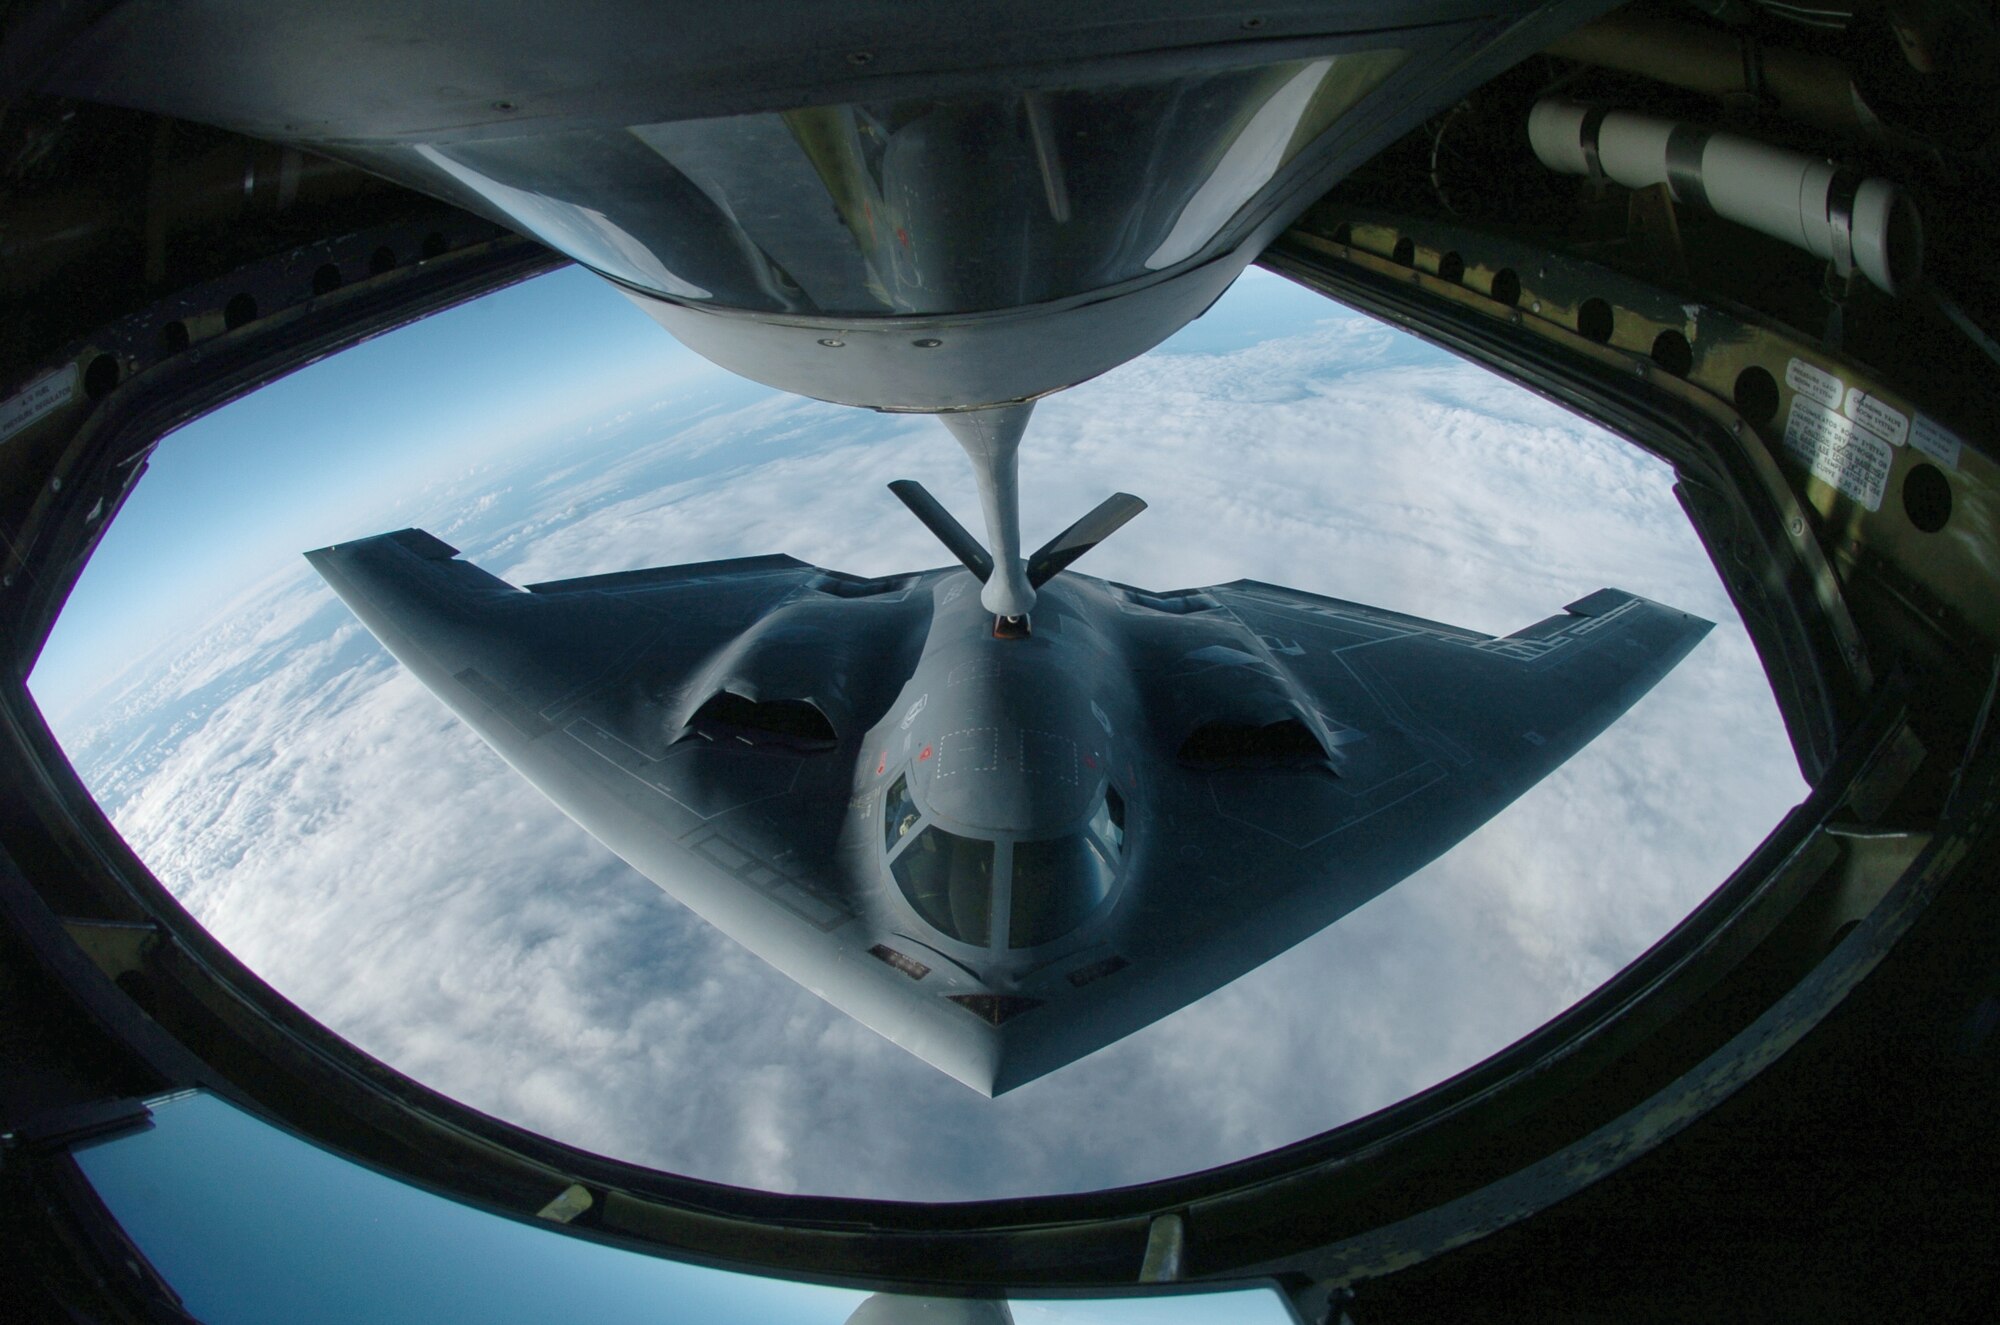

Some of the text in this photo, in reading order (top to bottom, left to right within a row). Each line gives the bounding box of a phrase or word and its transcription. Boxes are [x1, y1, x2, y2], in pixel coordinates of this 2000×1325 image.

[35, 386, 71, 410] REGULATOR
[1791, 408, 1814, 426] CHARGE
[1816, 423, 1832, 436] WITH
[1834, 433, 1846, 444] DRY
[1794, 401, 1837, 429] ACCUMULATOR
[1840, 426, 1858, 441] BOOM
[1861, 439, 1885, 457] SYSTEM
[1874, 417, 1894, 432] SYSTEM
[1817, 443, 1829, 455] ARE
[1832, 452, 1844, 464] FOR
[1816, 461, 1834, 478] CURVE
[1823, 456, 1867, 488] TEMPERATURES
[1869, 485, 1880, 496] USE
